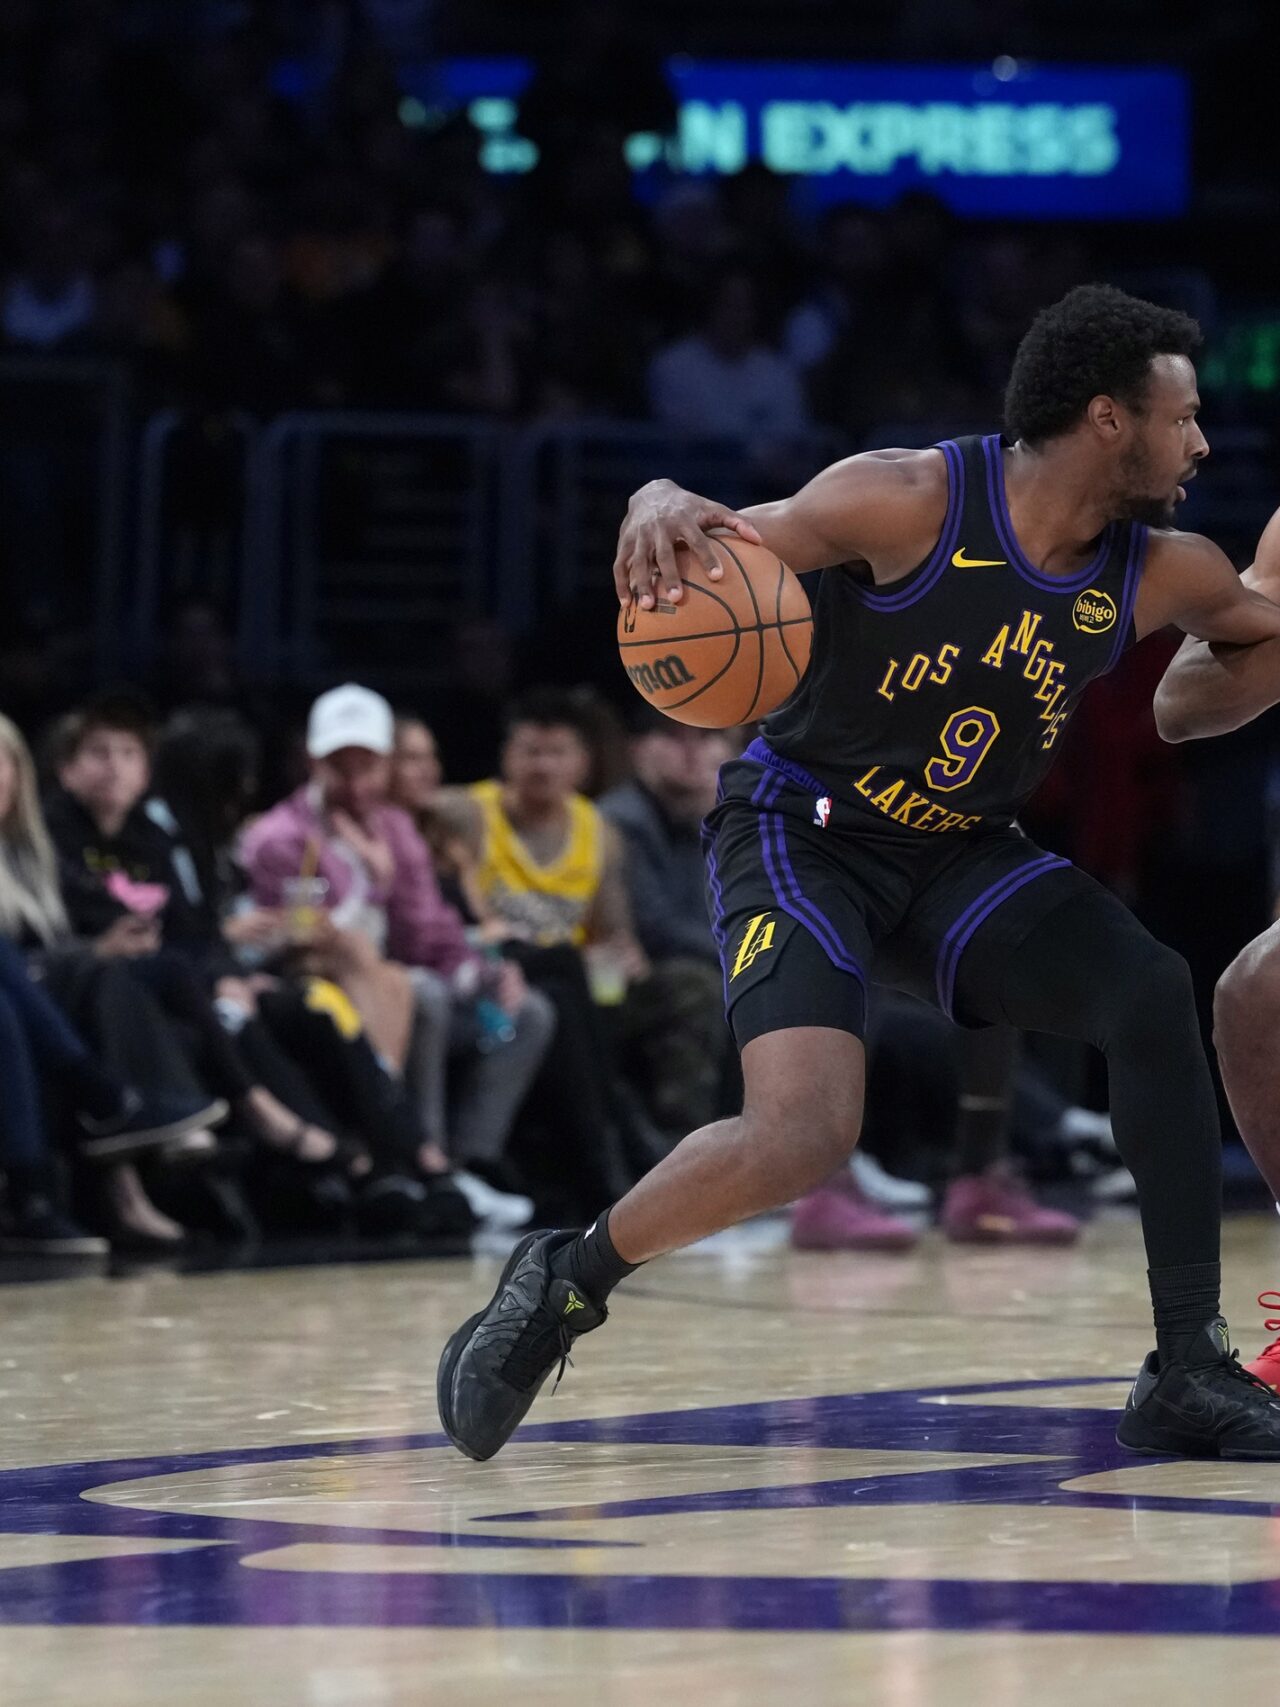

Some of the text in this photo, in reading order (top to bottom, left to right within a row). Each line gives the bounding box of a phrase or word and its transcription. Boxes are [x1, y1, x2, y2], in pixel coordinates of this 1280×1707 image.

[762, 100, 1120, 175] EXPRESS
[1076, 600, 1113, 622] bibigo
[877, 610, 1069, 749] LOS ANGELS
[924, 705, 1001, 793] 9
[853, 765, 982, 833] LAKERS
